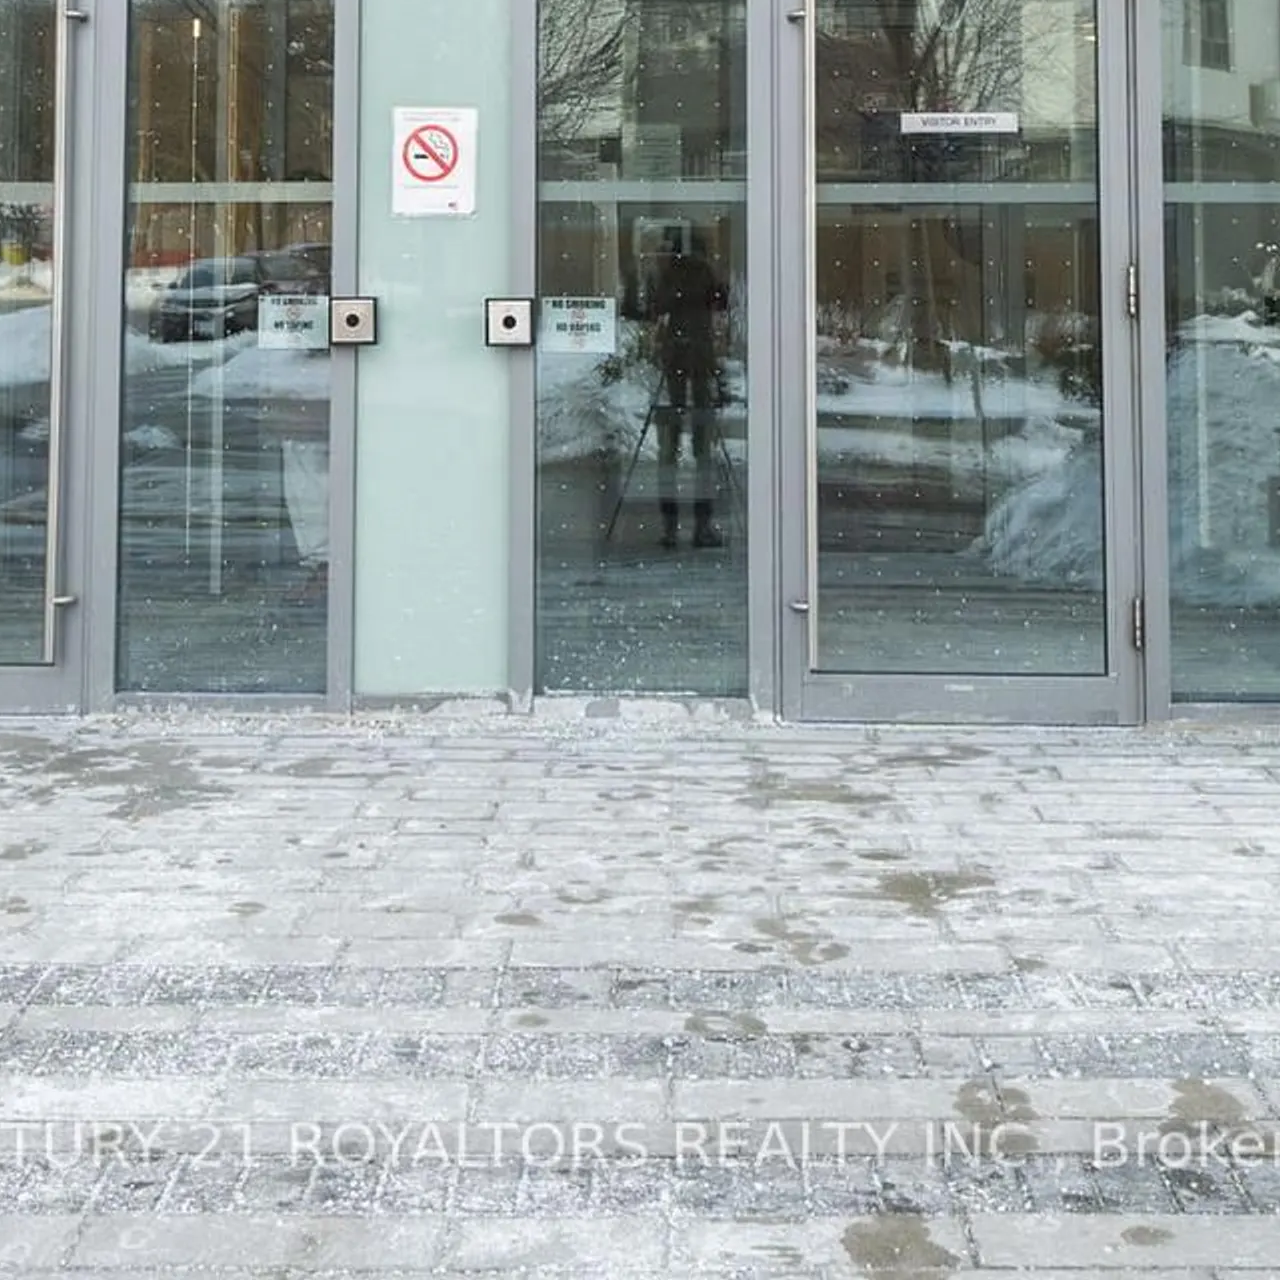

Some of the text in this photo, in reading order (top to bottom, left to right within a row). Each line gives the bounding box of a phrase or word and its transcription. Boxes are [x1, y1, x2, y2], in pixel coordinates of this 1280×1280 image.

[920, 116, 997, 126] VISITOR ENTRY
[552, 300, 605, 309] NO SMOKING
